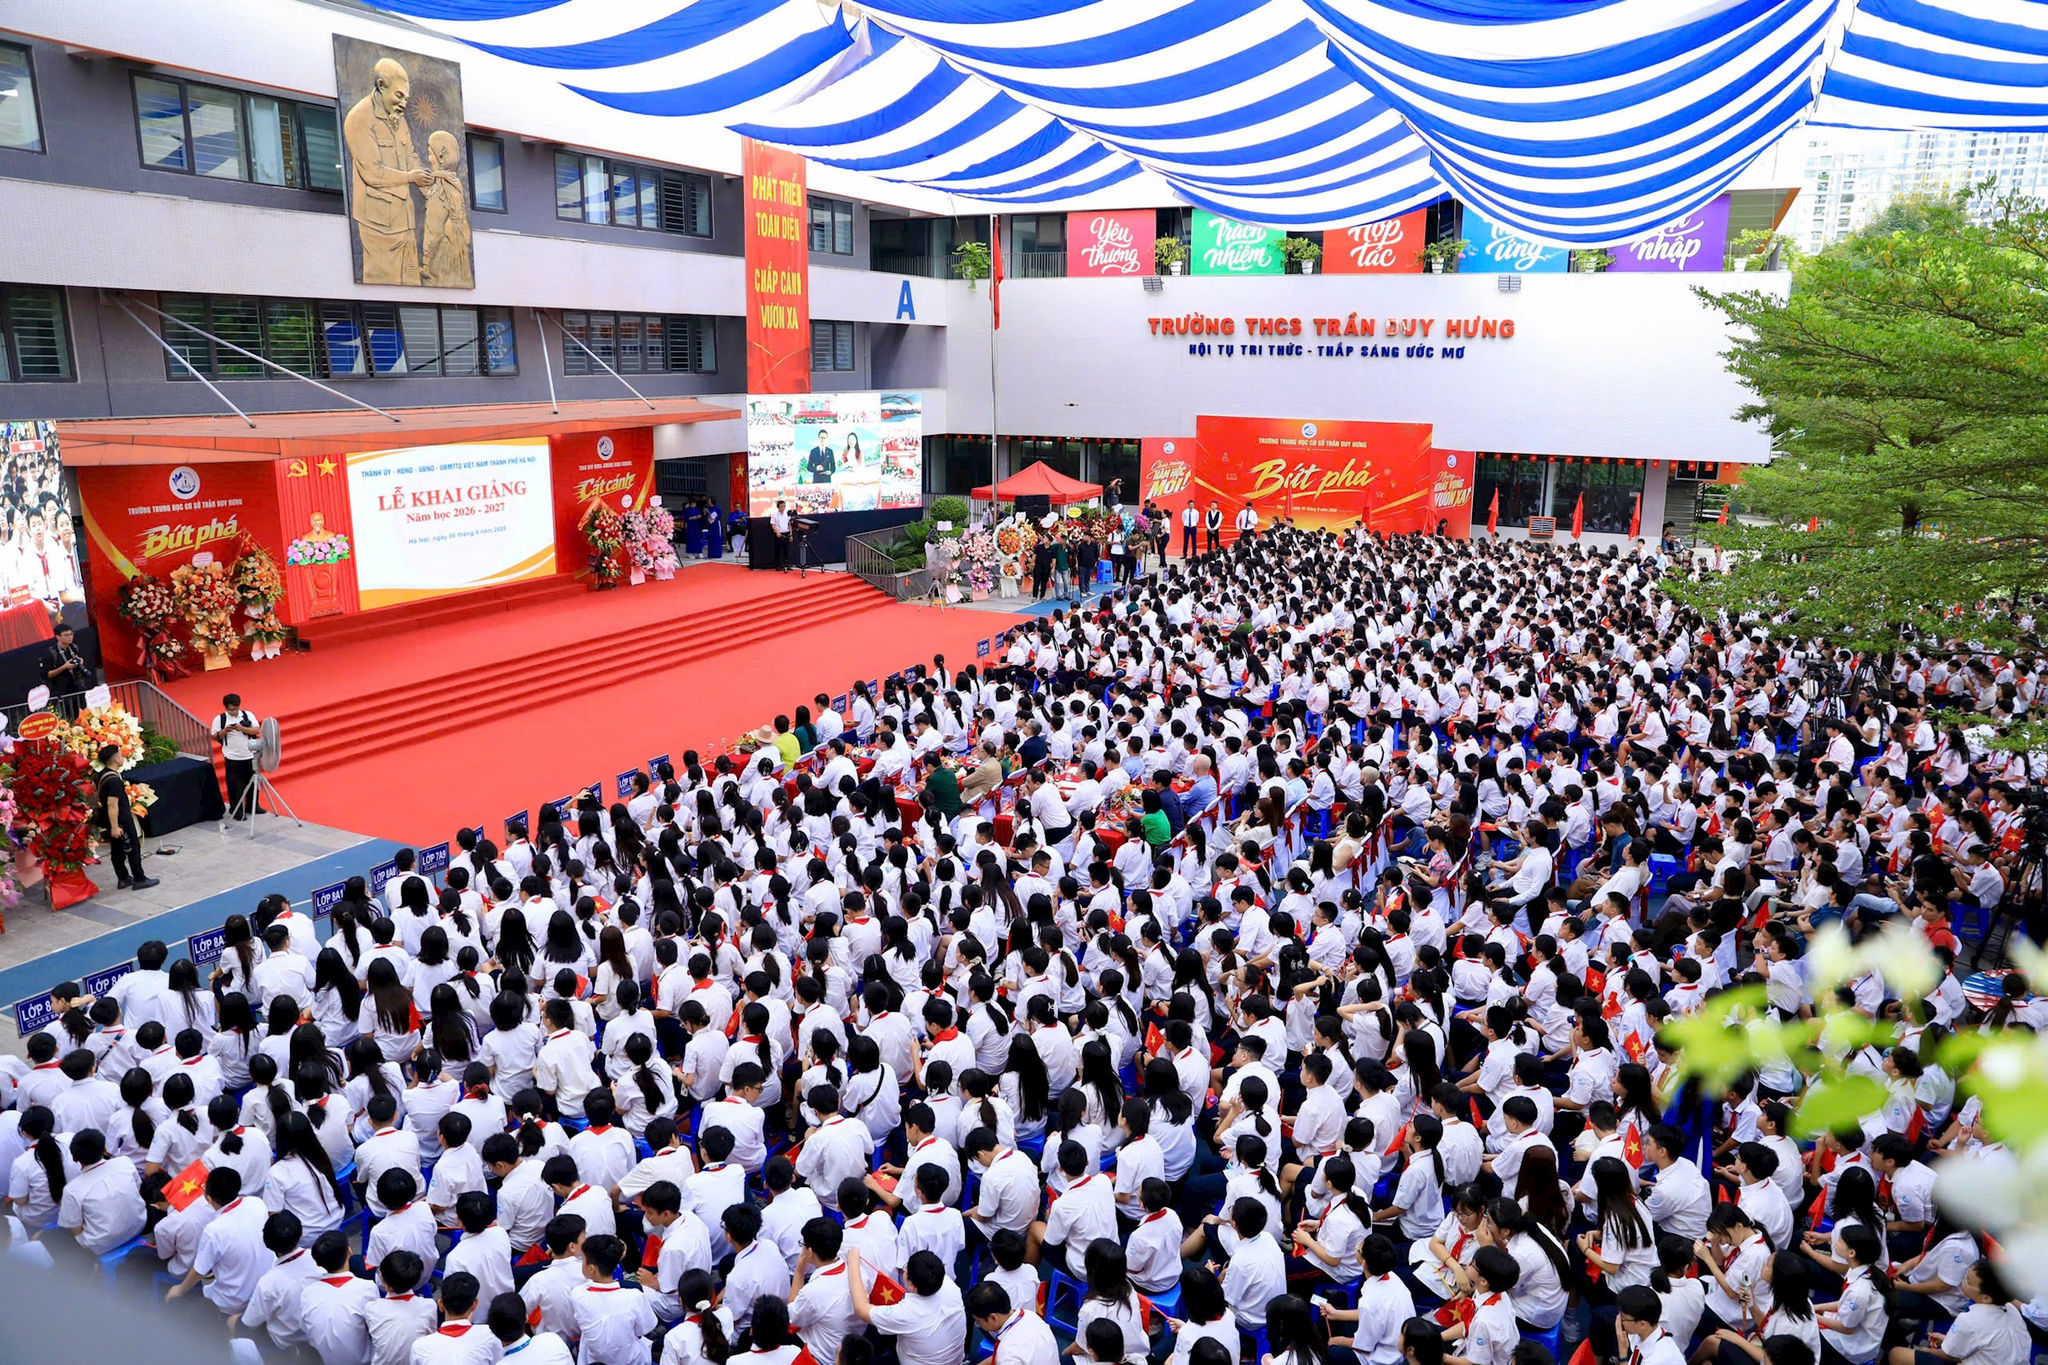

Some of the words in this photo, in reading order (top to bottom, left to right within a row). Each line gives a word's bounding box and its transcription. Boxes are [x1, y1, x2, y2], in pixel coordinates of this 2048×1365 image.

[752, 171, 778, 202] PHÁT
[756, 207, 780, 239] TOÀN
[782, 211, 801, 247] DIỆN
[1090, 216, 1133, 248] Yêu
[1203, 242, 1272, 271] nhiệm
[780, 266, 802, 296] CÁNH
[895, 280, 916, 320] A
[761, 302, 785, 329] VƯƠN
[786, 307, 800, 330] XA
[1147, 312, 1236, 336] TRƯỜNG
[1244, 318, 1304, 336] THCS
[1384, 318, 1435, 337] DUY
[1445, 315, 1516, 339] HƯNG
[1188, 342, 1212, 357] HỘI
[1217, 344, 1235, 358] TỤ
[1240, 344, 1263, 356] TRI
[1268, 342, 1304, 356] THỨC
[1360, 344, 1400, 358] SÁNG
[1406, 343, 1435, 359] ƯỚC
[1441, 346, 1466, 360] MƠ
[1241, 458, 1322, 499] Bứt
[1313, 457, 1380, 503] phá
[377, 486, 406, 511] LỄ
[411, 487, 463, 508] KHAI
[467, 478, 527, 501] GIẢNG
[406, 512, 431, 524] Năm
[433, 509, 452, 521] học
[453, 505, 476, 517] 2026
[484, 502, 505, 513] 2027
[143, 524, 195, 558] Bứt
[194, 514, 238, 551] phá
[422, 852, 435, 866] LỚP
[373, 869, 386, 885] LỚP
[316, 892, 332, 907] LỚP
[194, 938, 212, 954] LỚP
[198, 949, 217, 961] CLASS
[90, 978, 110, 995] LỚP
[21, 1003, 43, 1022] LỚP
[27, 1014, 50, 1029] CLASS
